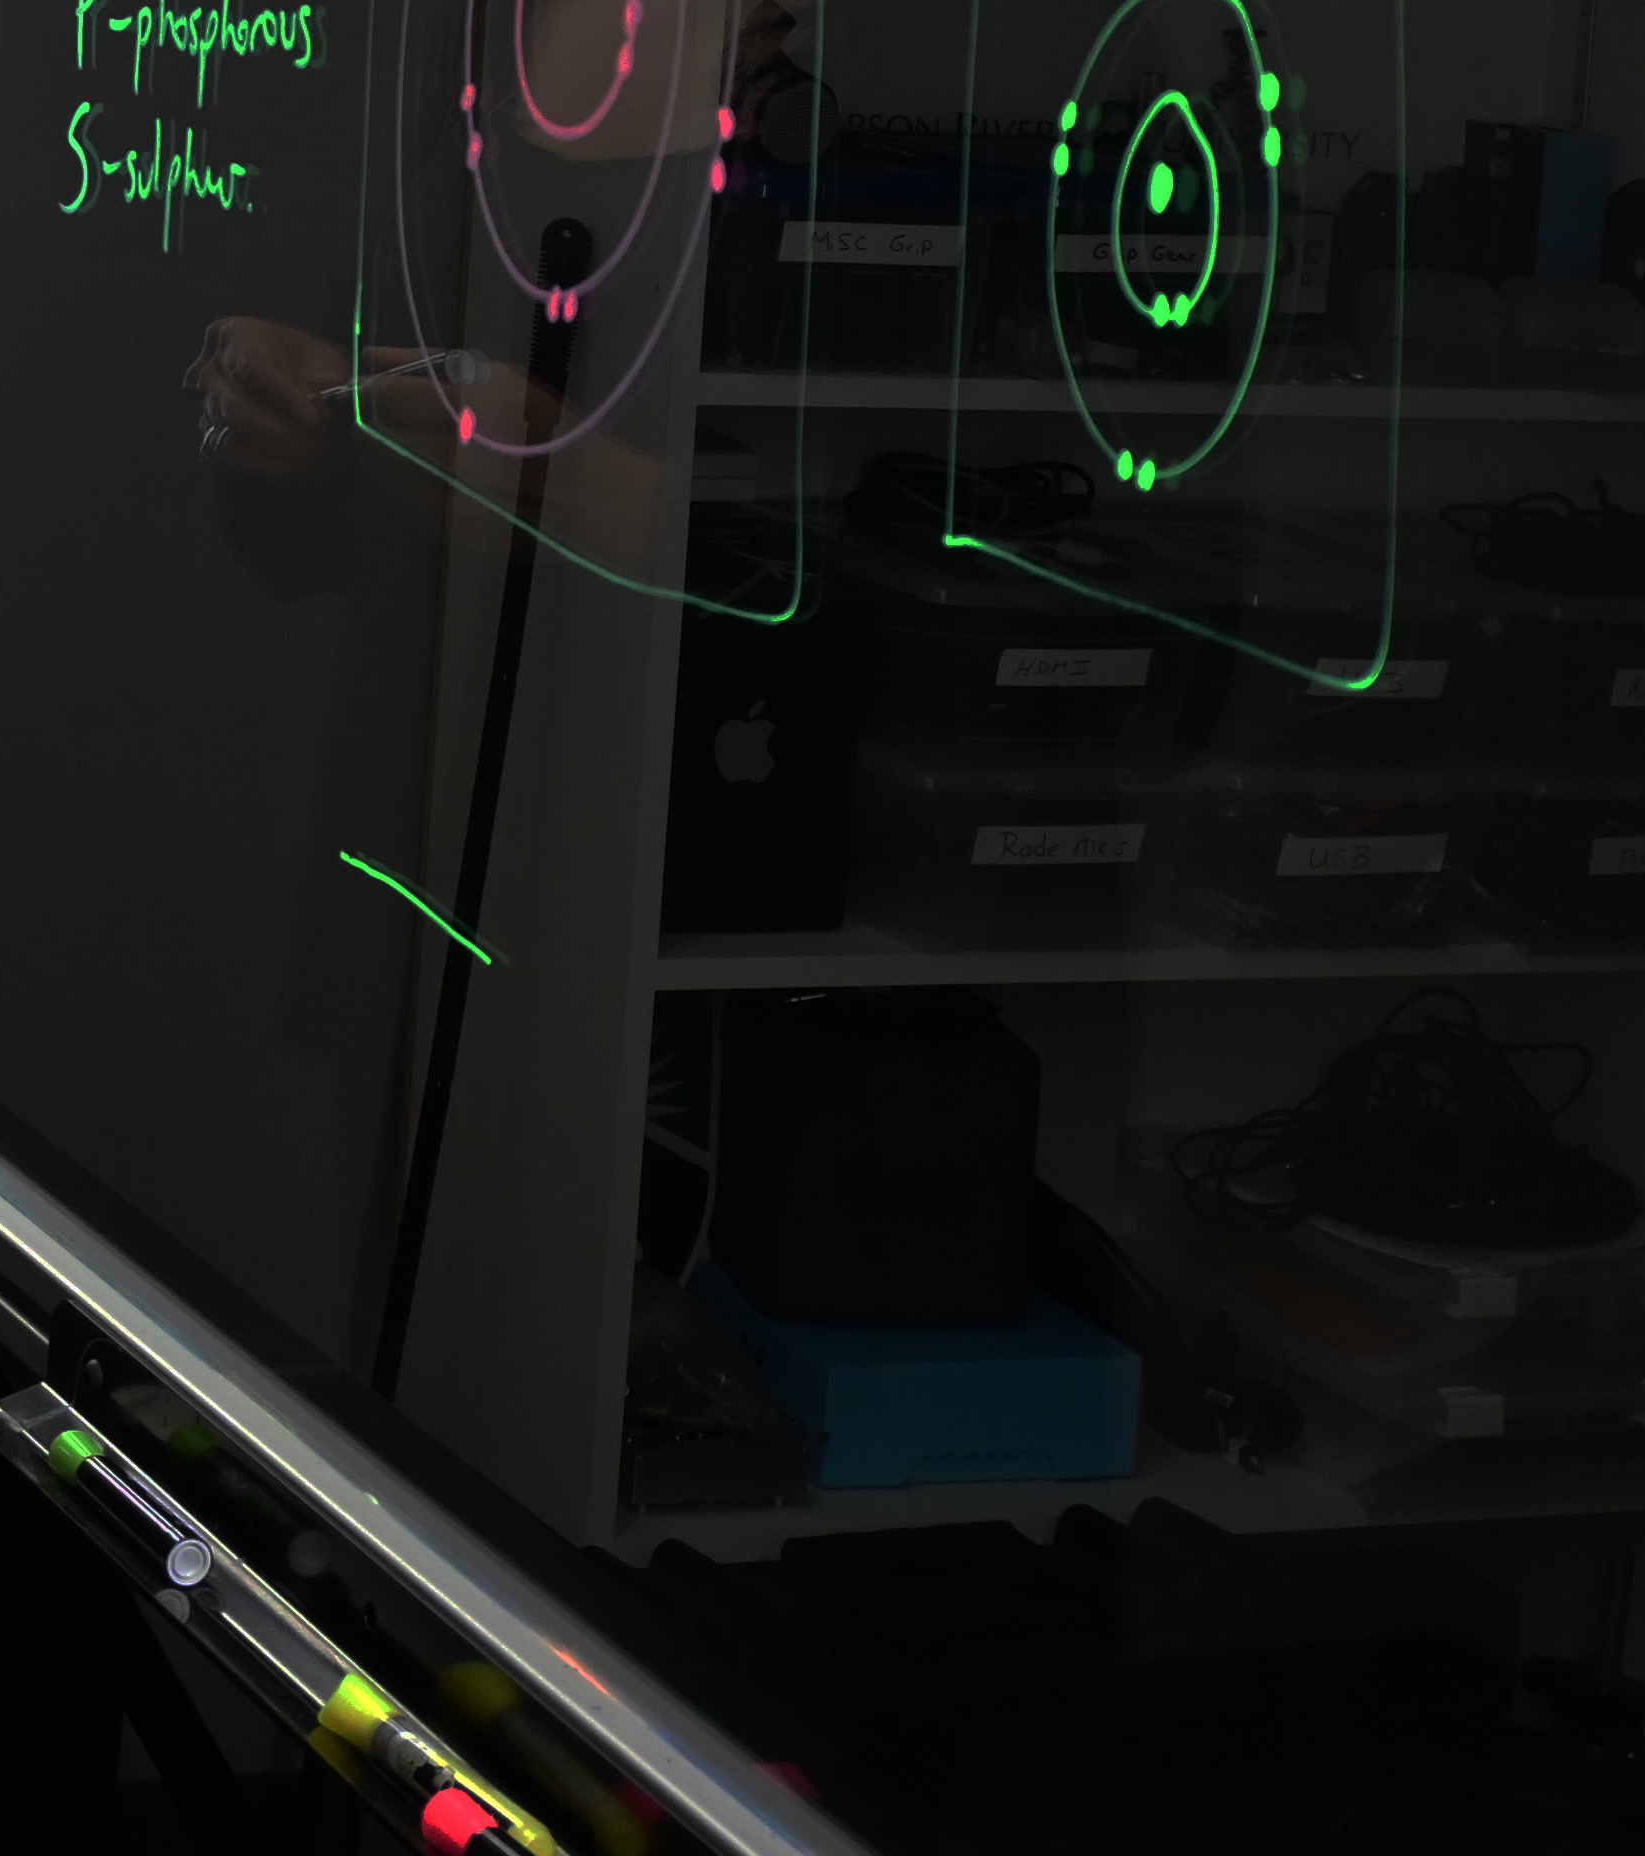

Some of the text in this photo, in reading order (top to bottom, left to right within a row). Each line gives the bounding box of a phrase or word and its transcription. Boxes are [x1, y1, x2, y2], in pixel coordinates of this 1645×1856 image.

[889, 233, 934, 256] Grip
[1092, 242, 1197, 266] Gp Gear
[1015, 657, 1092, 677] HDMI
[1000, 831, 1060, 859] Rode
[1308, 845, 1372, 871] USB
